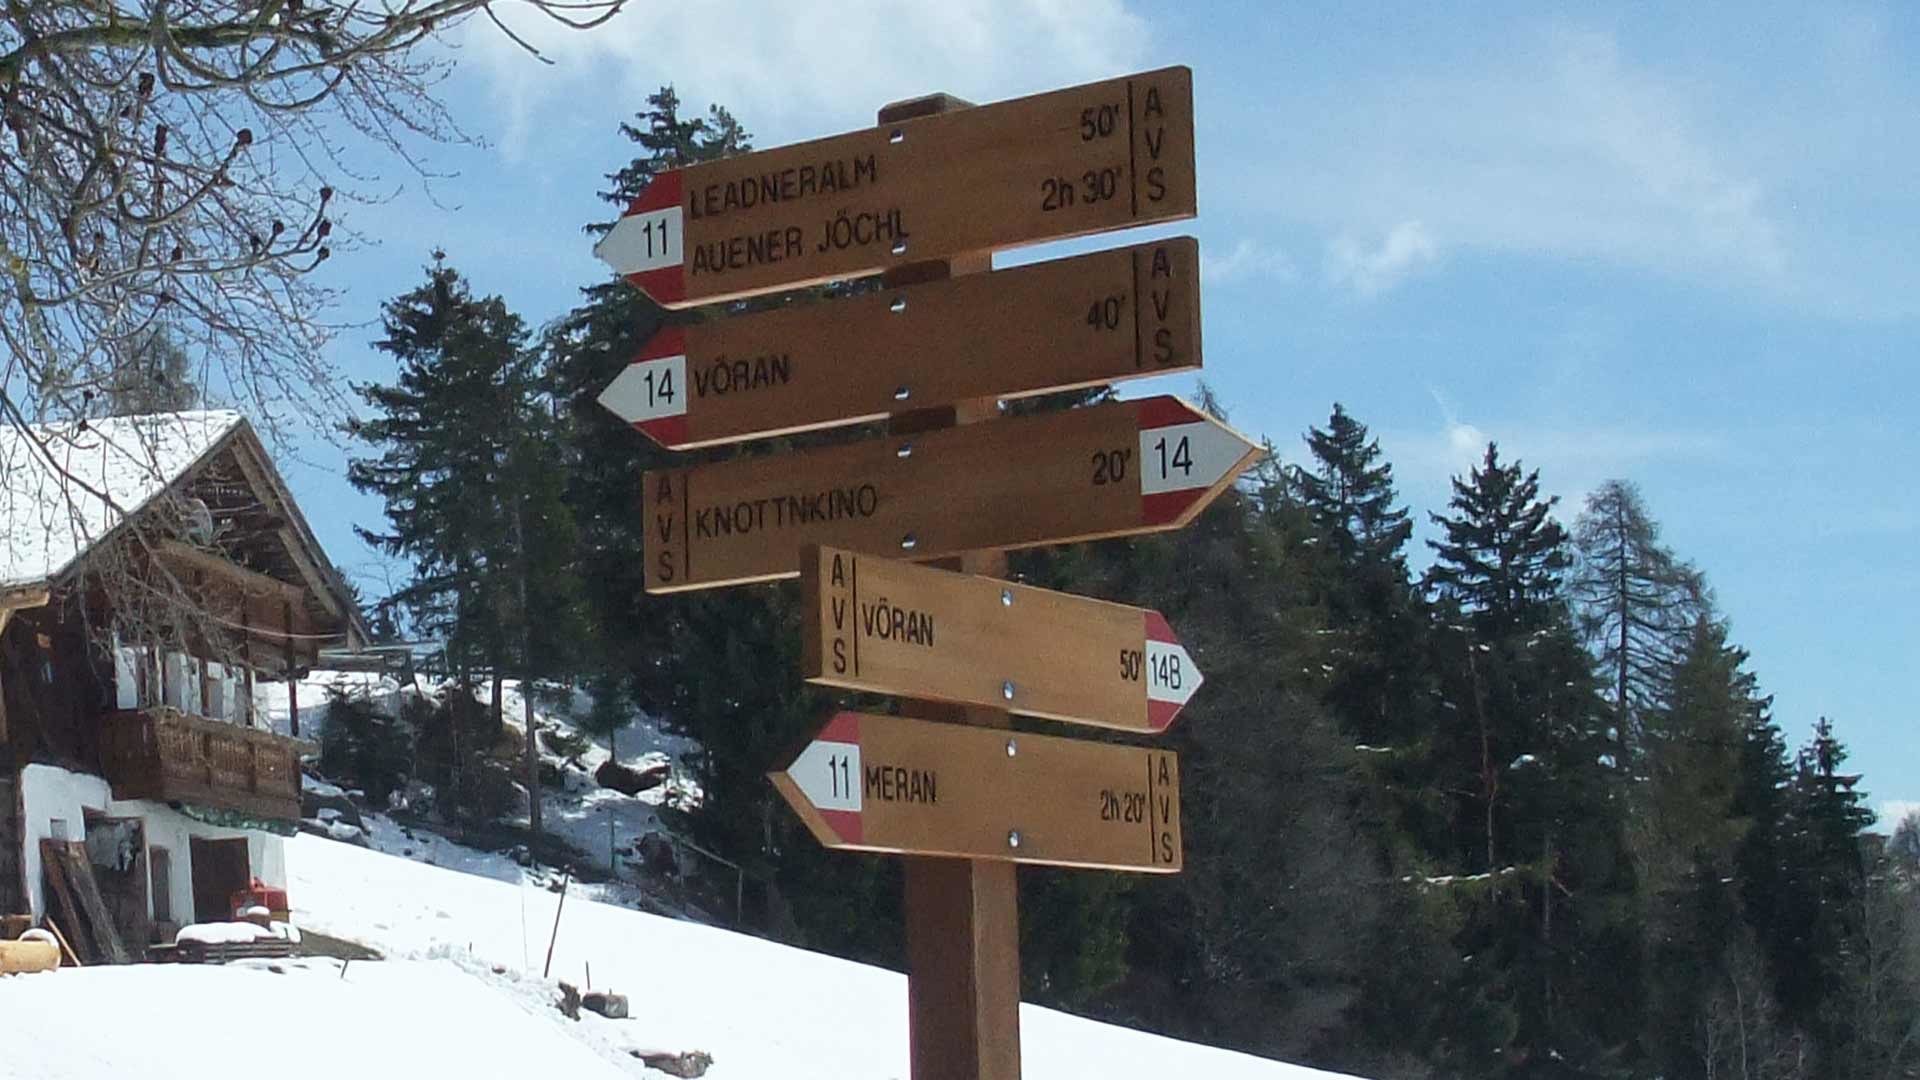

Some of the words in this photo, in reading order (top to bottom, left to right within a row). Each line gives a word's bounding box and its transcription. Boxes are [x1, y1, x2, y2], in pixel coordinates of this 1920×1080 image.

[1080, 103, 1119, 141] 50'
[690, 153, 878, 219] LEADNERALM
[1041, 176, 1075, 212] 2h
[1082, 167, 1122, 204] 30'
[642, 218, 668, 258] 11
[691, 225, 804, 277] AUENER
[818, 206, 910, 252] JÖCHL
[1087, 294, 1126, 331] 40'
[644, 367, 675, 408] 14
[694, 354, 790, 398] VÖRAN
[1091, 448, 1131, 486] 20'
[1154, 435, 1193, 480] 14
[696, 483, 878, 539] KNOTTNKINO
[862, 597, 934, 648] VÖRAN
[1120, 649, 1142, 682] 50'
[1150, 654, 1182, 690] 14B
[829, 753, 850, 800] 11
[865, 765, 937, 803] MERAN
[1100, 790, 1119, 821] 2h
[1124, 793, 1145, 824] 20'
